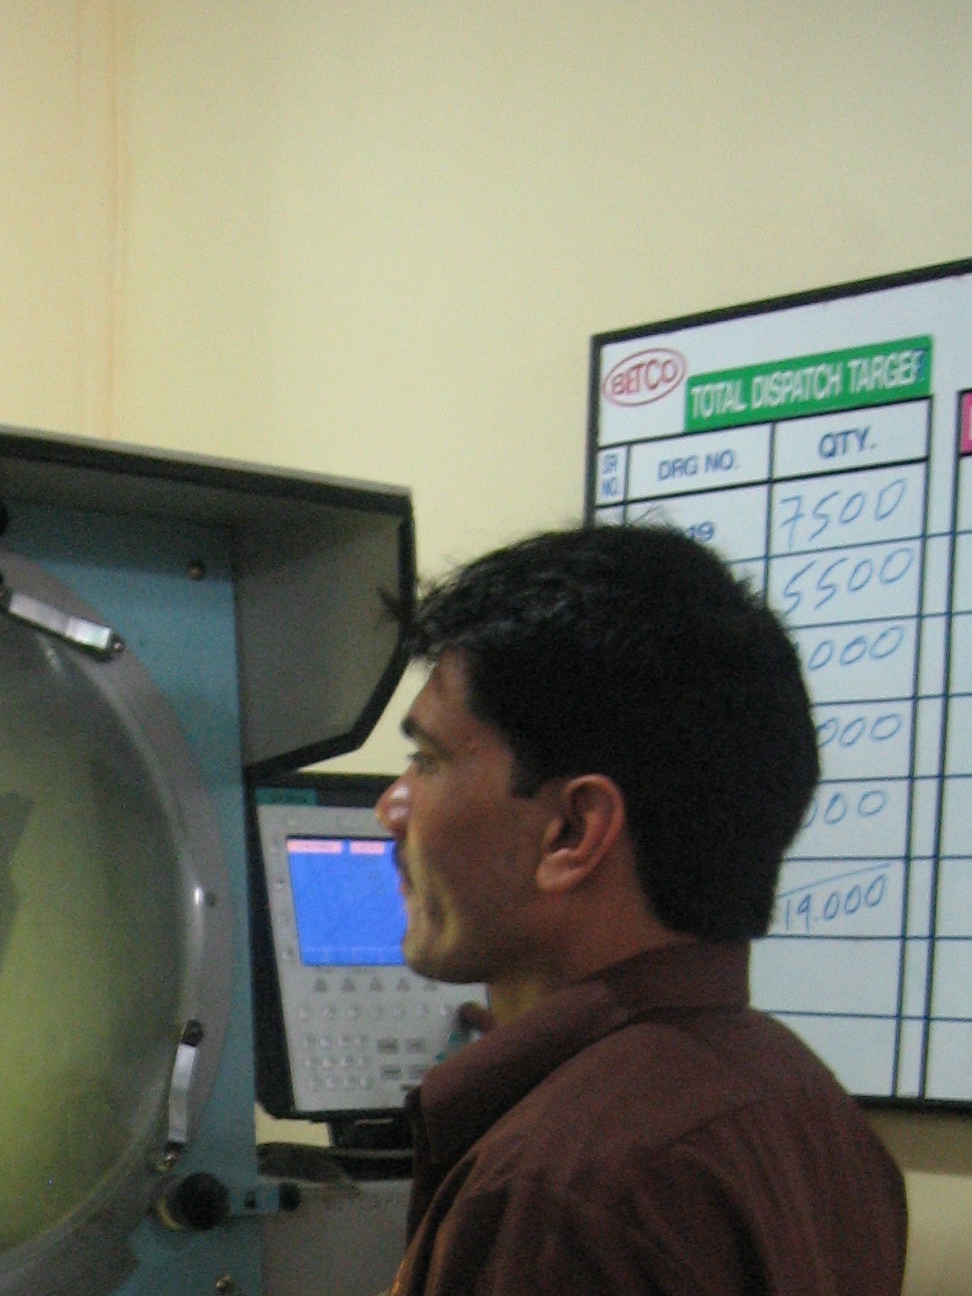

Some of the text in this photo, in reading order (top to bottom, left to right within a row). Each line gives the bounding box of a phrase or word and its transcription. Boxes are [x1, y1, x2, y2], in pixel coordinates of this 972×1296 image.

[611, 358, 678, 396] BETCO
[690, 379, 747, 419] TOTAL
[751, 361, 844, 410] DISPATCH
[819, 426, 877, 459] QTY.
[658, 456, 699, 481] DRG
[779, 478, 906, 550] 7500
[783, 547, 914, 617] 5500
[794, 625, 904, 671] 000
